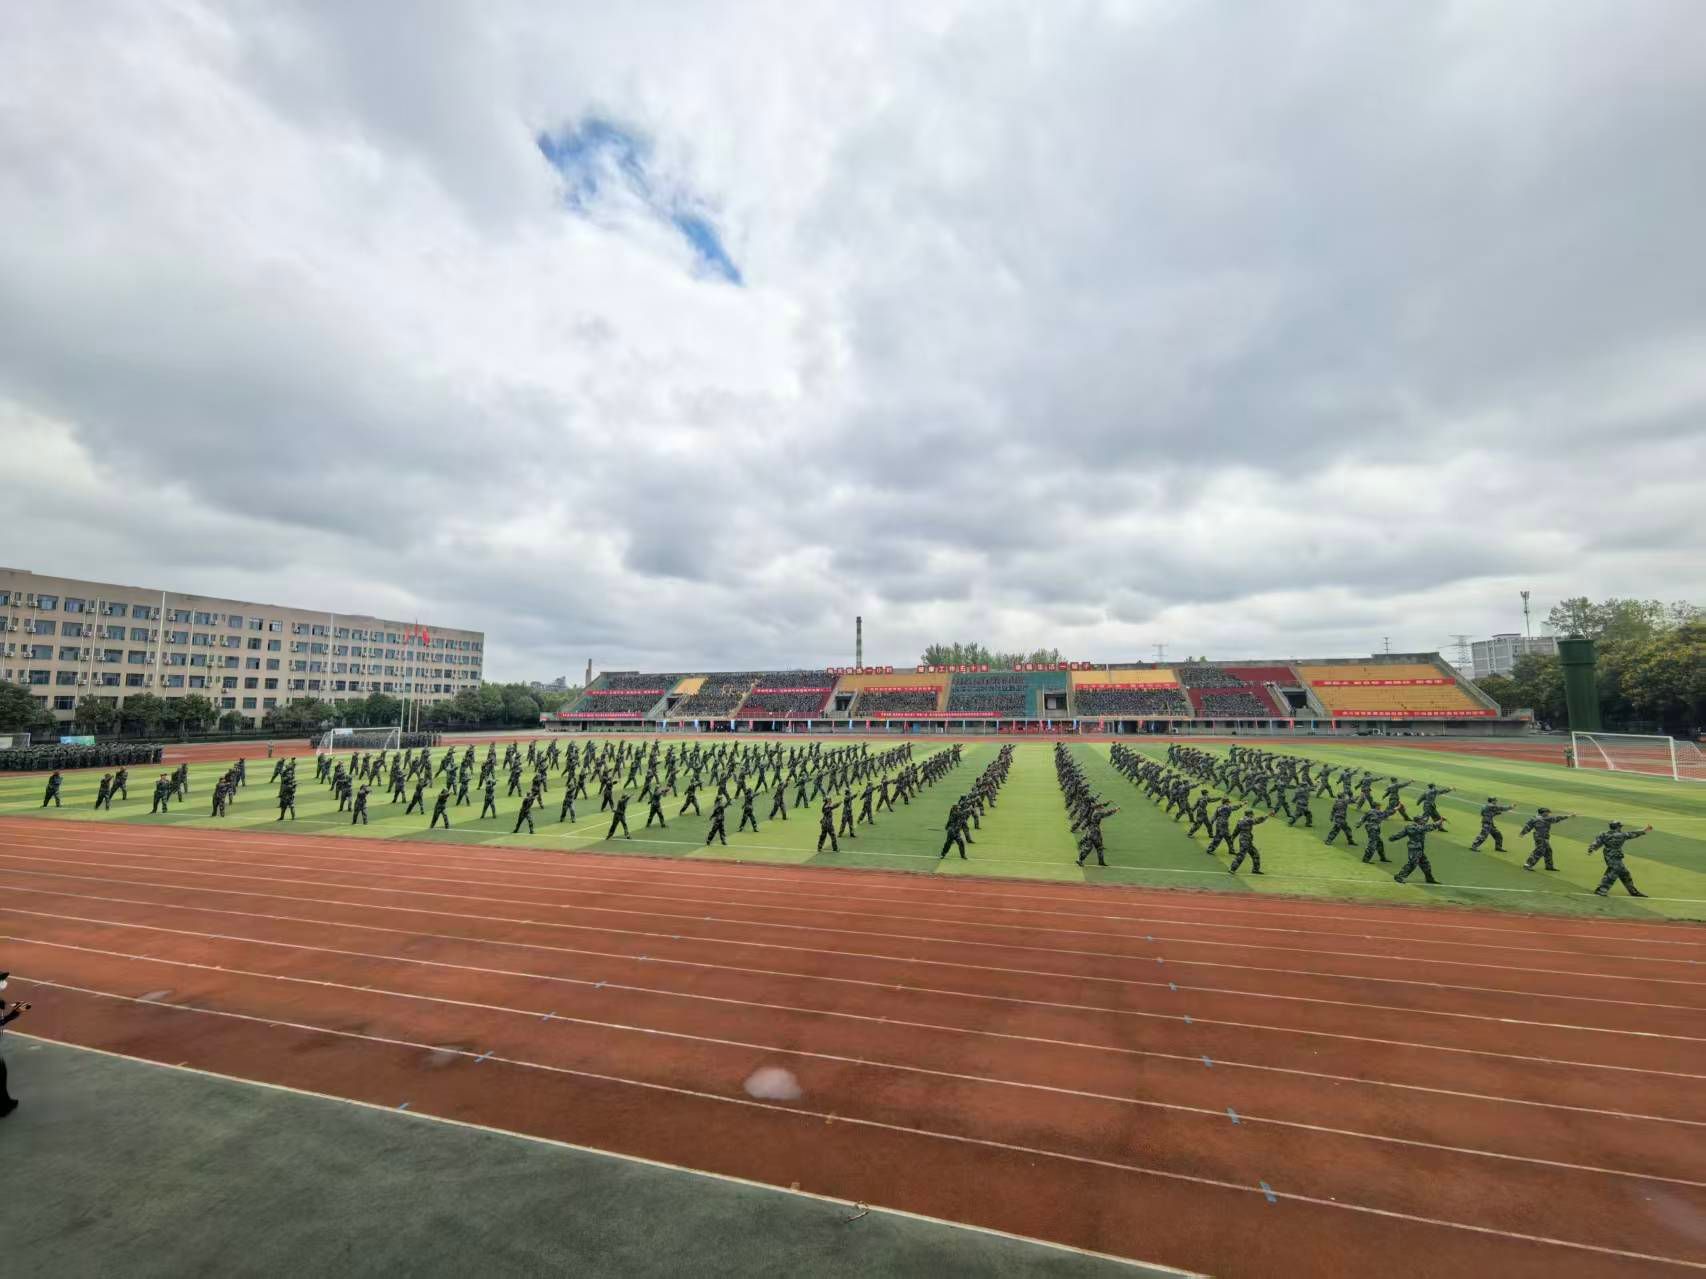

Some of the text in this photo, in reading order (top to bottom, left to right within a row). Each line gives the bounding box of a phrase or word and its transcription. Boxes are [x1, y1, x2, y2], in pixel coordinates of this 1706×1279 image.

[917, 663, 988, 673] 工作五十
[1015, 661, 1091, 671] 生活一子
